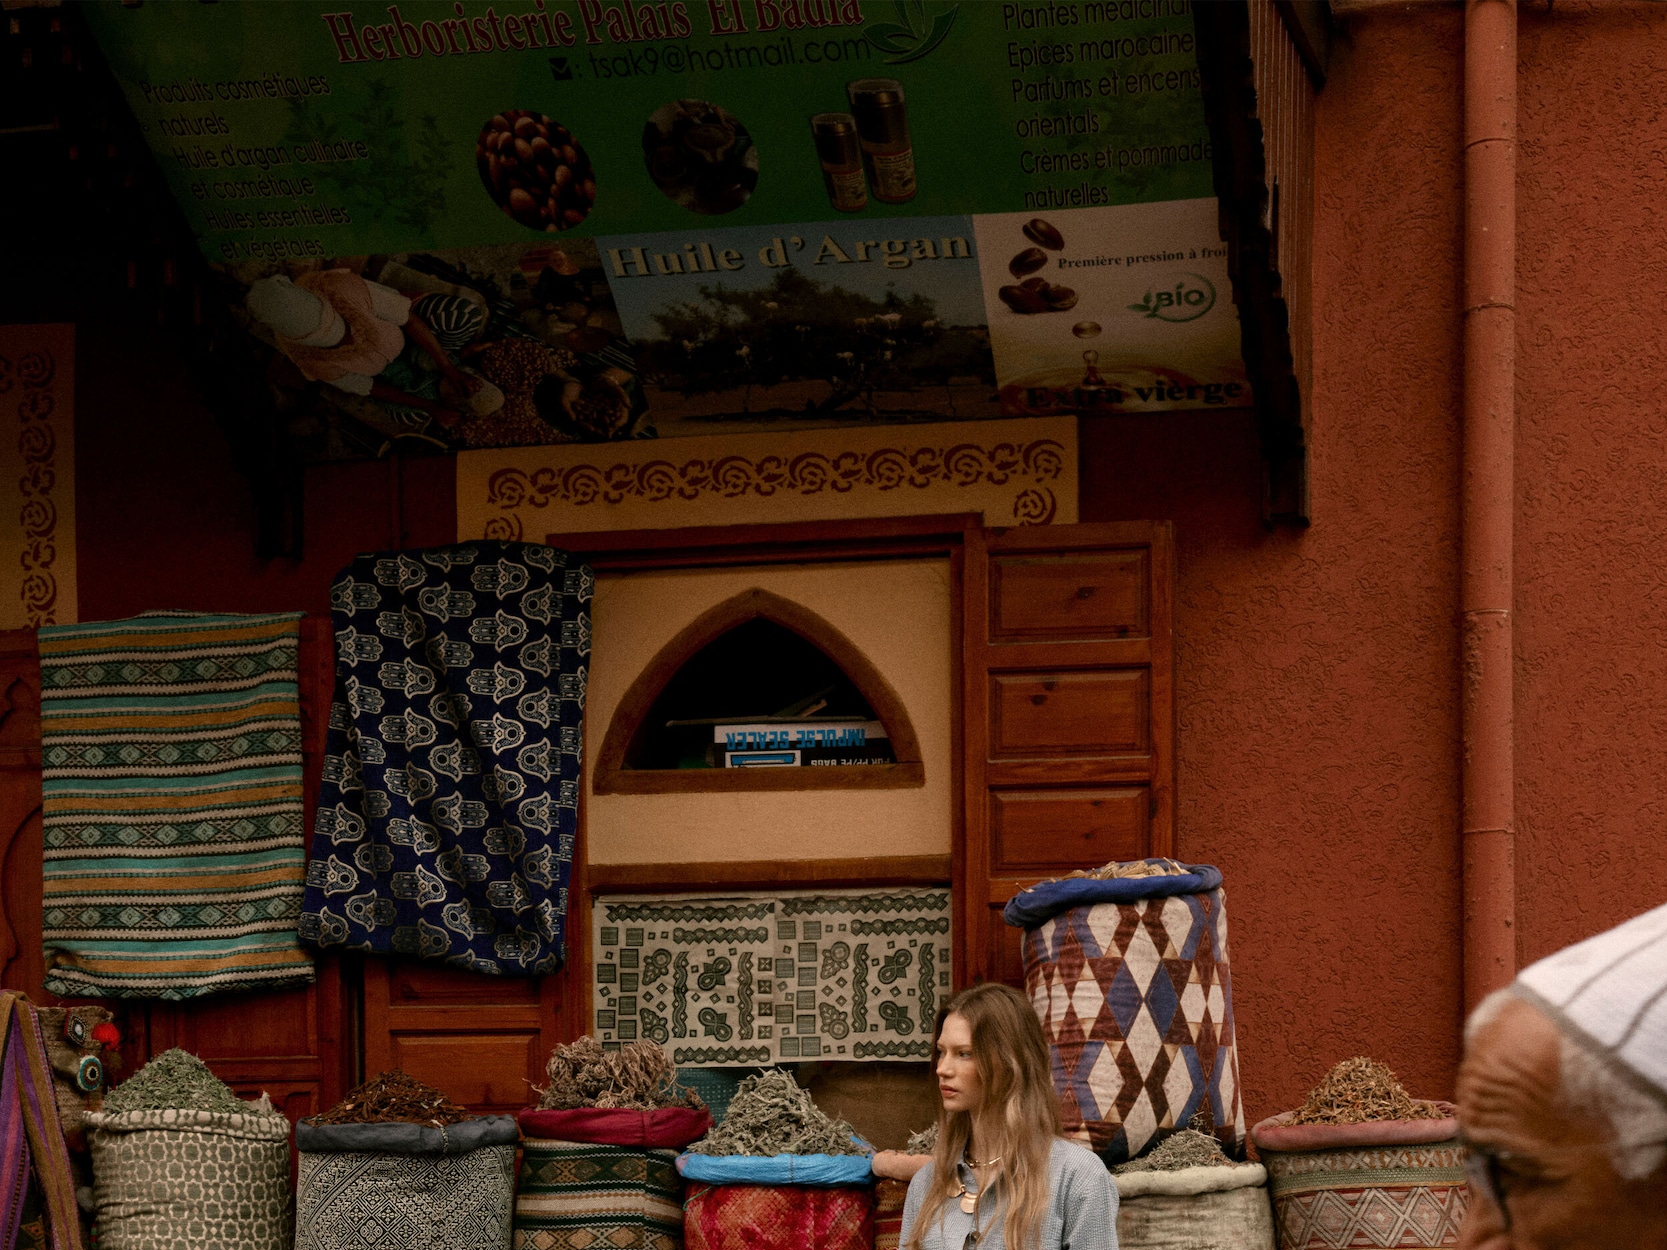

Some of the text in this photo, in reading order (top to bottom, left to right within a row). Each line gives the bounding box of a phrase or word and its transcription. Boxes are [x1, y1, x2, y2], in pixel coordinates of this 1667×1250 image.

[1003, 2, 1078, 30] Plantes
[322, 0, 576, 63] Herboristerie
[576, 0, 693, 45] Palais
[709, 0, 748, 35] El
[588, 37, 872, 80] tsak9@hotmail.com
[1008, 40, 1074, 72] Epices
[140, 72, 331, 104] Produits cosmétiques
[1012, 67, 1201, 103] Parfums et encens
[159, 111, 230, 137] naturels
[1016, 108, 1099, 138] orientals
[172, 135, 369, 171] Huile d'argan culinaire
[1020, 148, 1090, 174] Crèmes
[1095, 145, 1113, 169] et
[191, 174, 315, 202] et cosmétique
[1024, 182, 1109, 209] naturelles
[203, 203, 351, 231] Huiles essentielles
[220, 239, 239, 260] et
[607, 243, 744, 278] Huile
[1058, 254, 1122, 268] Première
[1126, 251, 1184, 266] pression
[1189, 248, 1197, 259] à
[1026, 386, 1124, 408] Extra
[726, 729, 866, 751] IMPULSE SEALER
